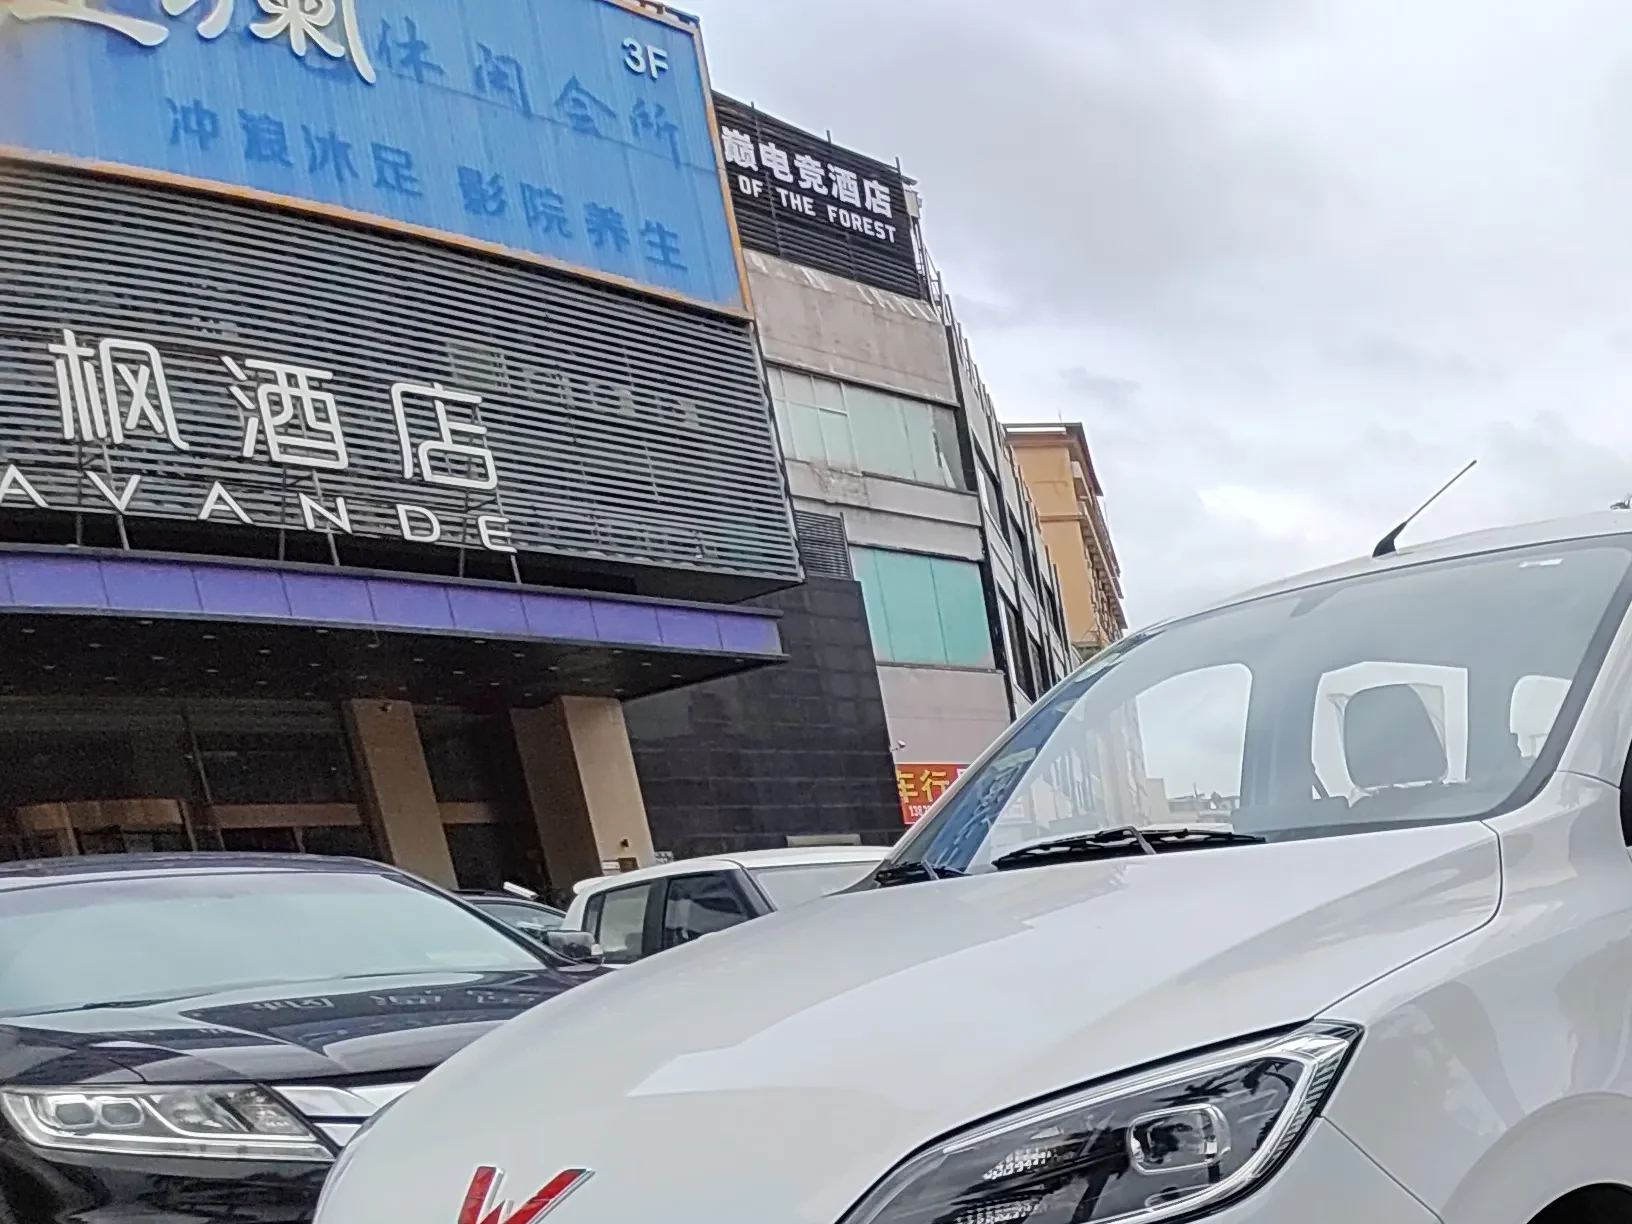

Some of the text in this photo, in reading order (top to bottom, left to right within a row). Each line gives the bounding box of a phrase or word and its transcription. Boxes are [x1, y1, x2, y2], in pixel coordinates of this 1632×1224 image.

[622, 37, 670, 81] 3F
[458, 165, 688, 273] 影院养生
[737, 174, 897, 244] OF THE FOREST
[47, 328, 499, 491] 枫酒店
[896, 769, 950, 804] 车行
